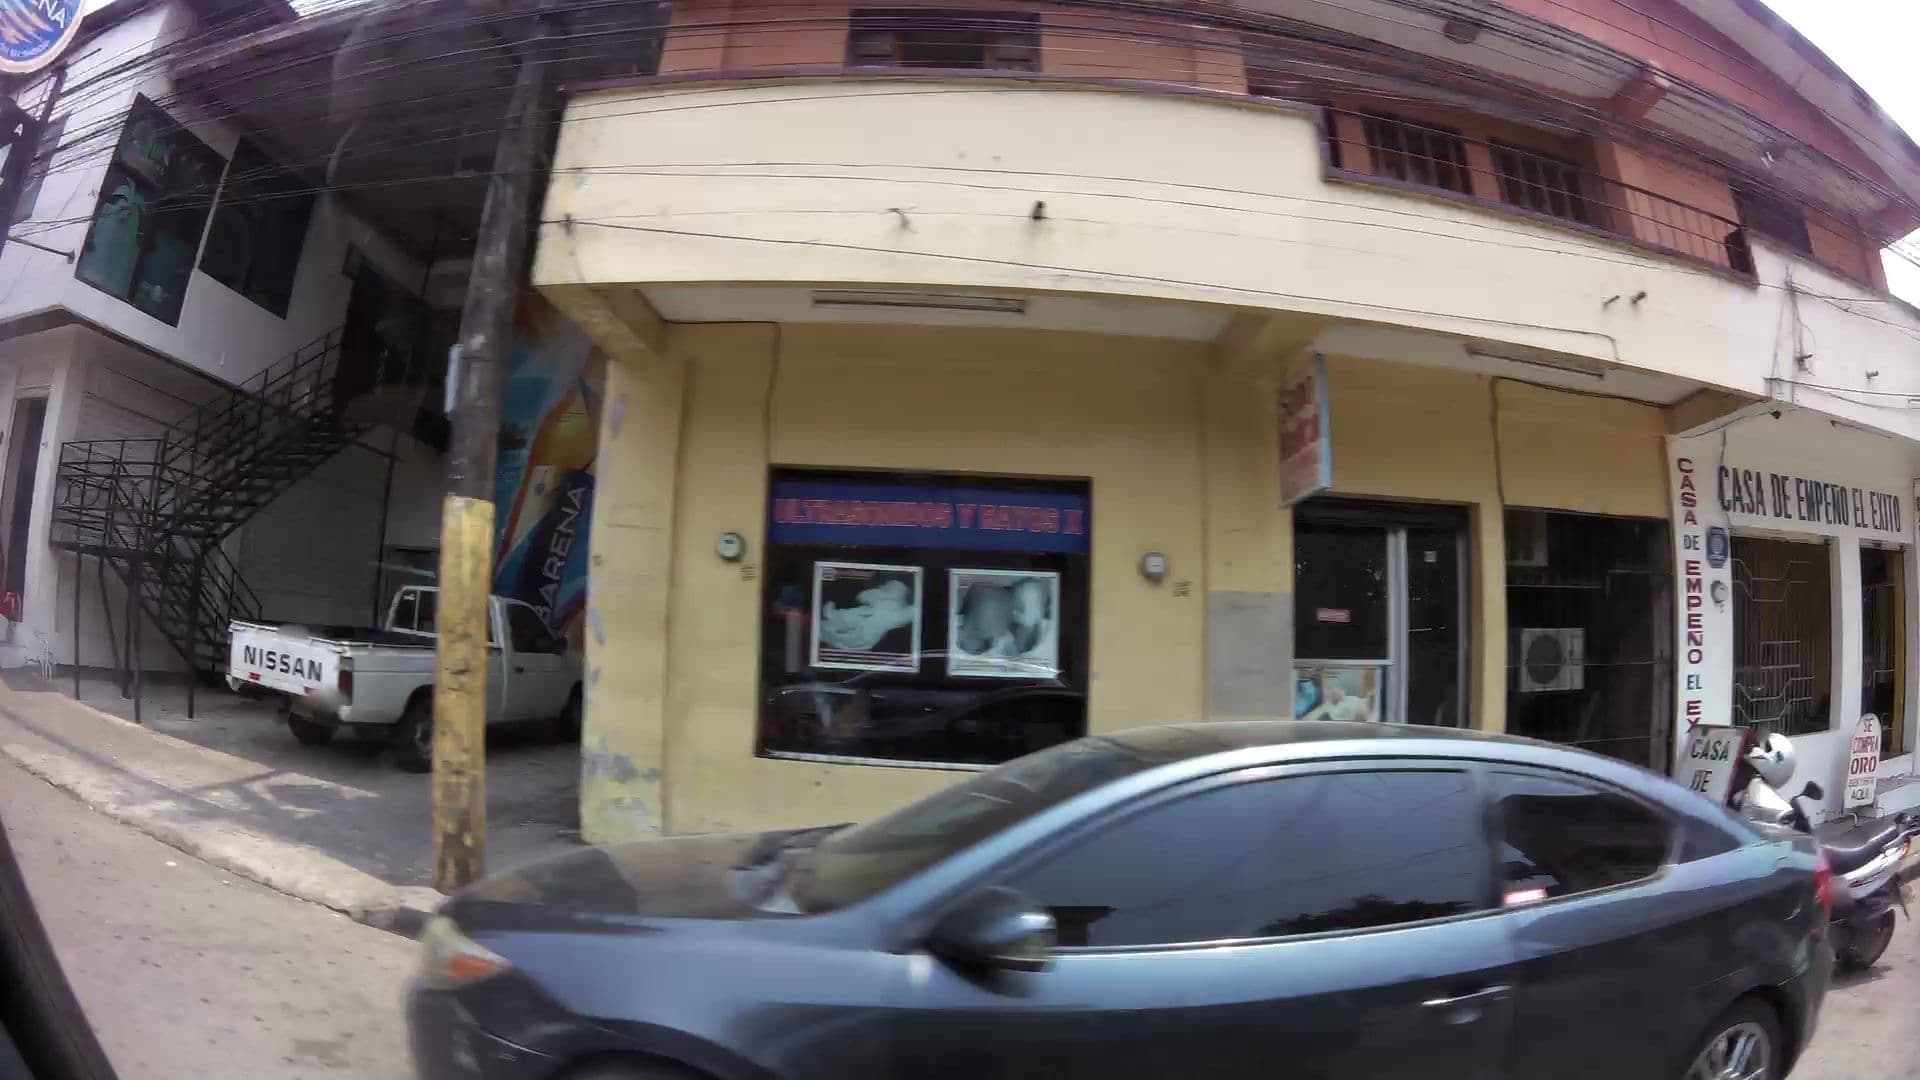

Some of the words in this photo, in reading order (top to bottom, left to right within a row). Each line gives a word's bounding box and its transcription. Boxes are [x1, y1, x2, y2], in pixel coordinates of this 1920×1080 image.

[1678, 457, 1698, 526] CASA
[1718, 464, 1767, 517] CASA
[1770, 472, 1793, 520] DE
[1851, 486, 1869, 529] EL
[1869, 490, 1902, 534] EXITO
[1683, 534, 1701, 551] DE
[243, 644, 323, 683] NISSAN
[1686, 673, 1703, 691] EL
[1690, 738, 1731, 761] CASA
[1850, 755, 1877, 775] ORO
[1690, 769, 1713, 793] DE
